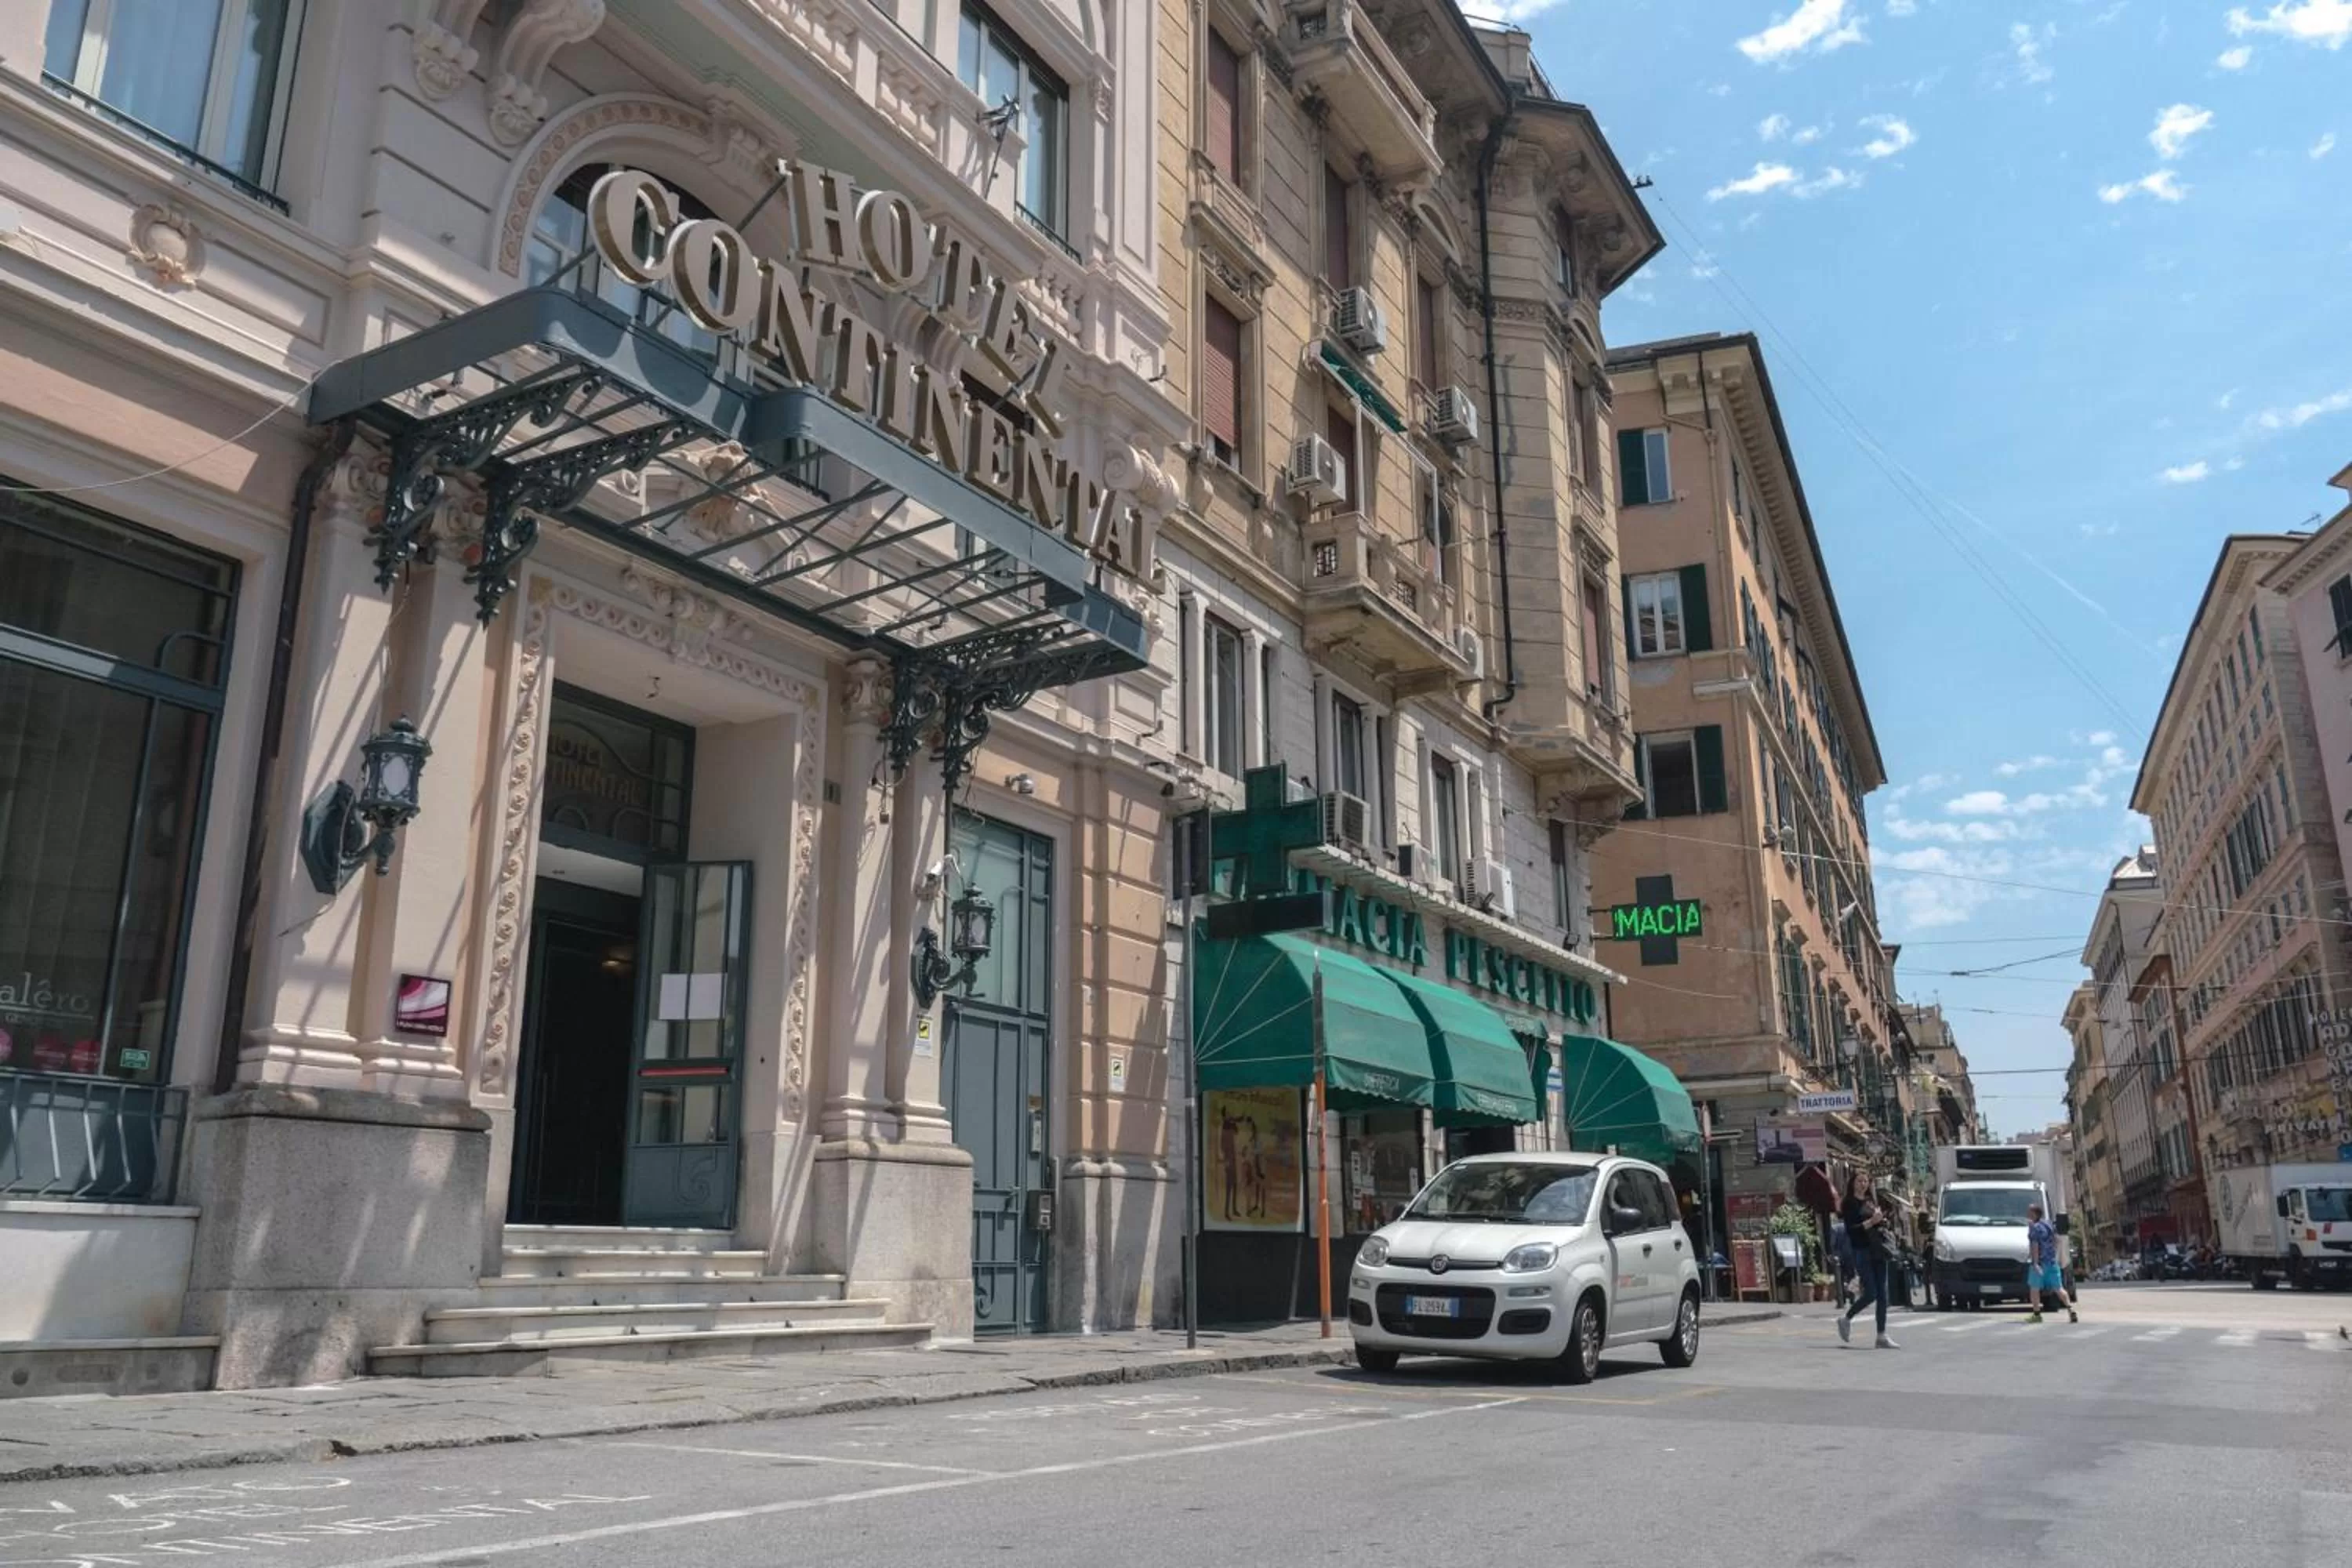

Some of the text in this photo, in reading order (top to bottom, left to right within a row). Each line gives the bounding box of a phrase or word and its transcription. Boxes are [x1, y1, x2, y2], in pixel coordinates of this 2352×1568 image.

[777, 158, 1073, 439] HOTEL
[587, 169, 1165, 594] CONTINENTAL
[1615, 902, 1699, 938] MACIA
[1444, 928, 1595, 1025] PESCETTO
[1801, 1096, 1853, 1108] TRATTORIA
